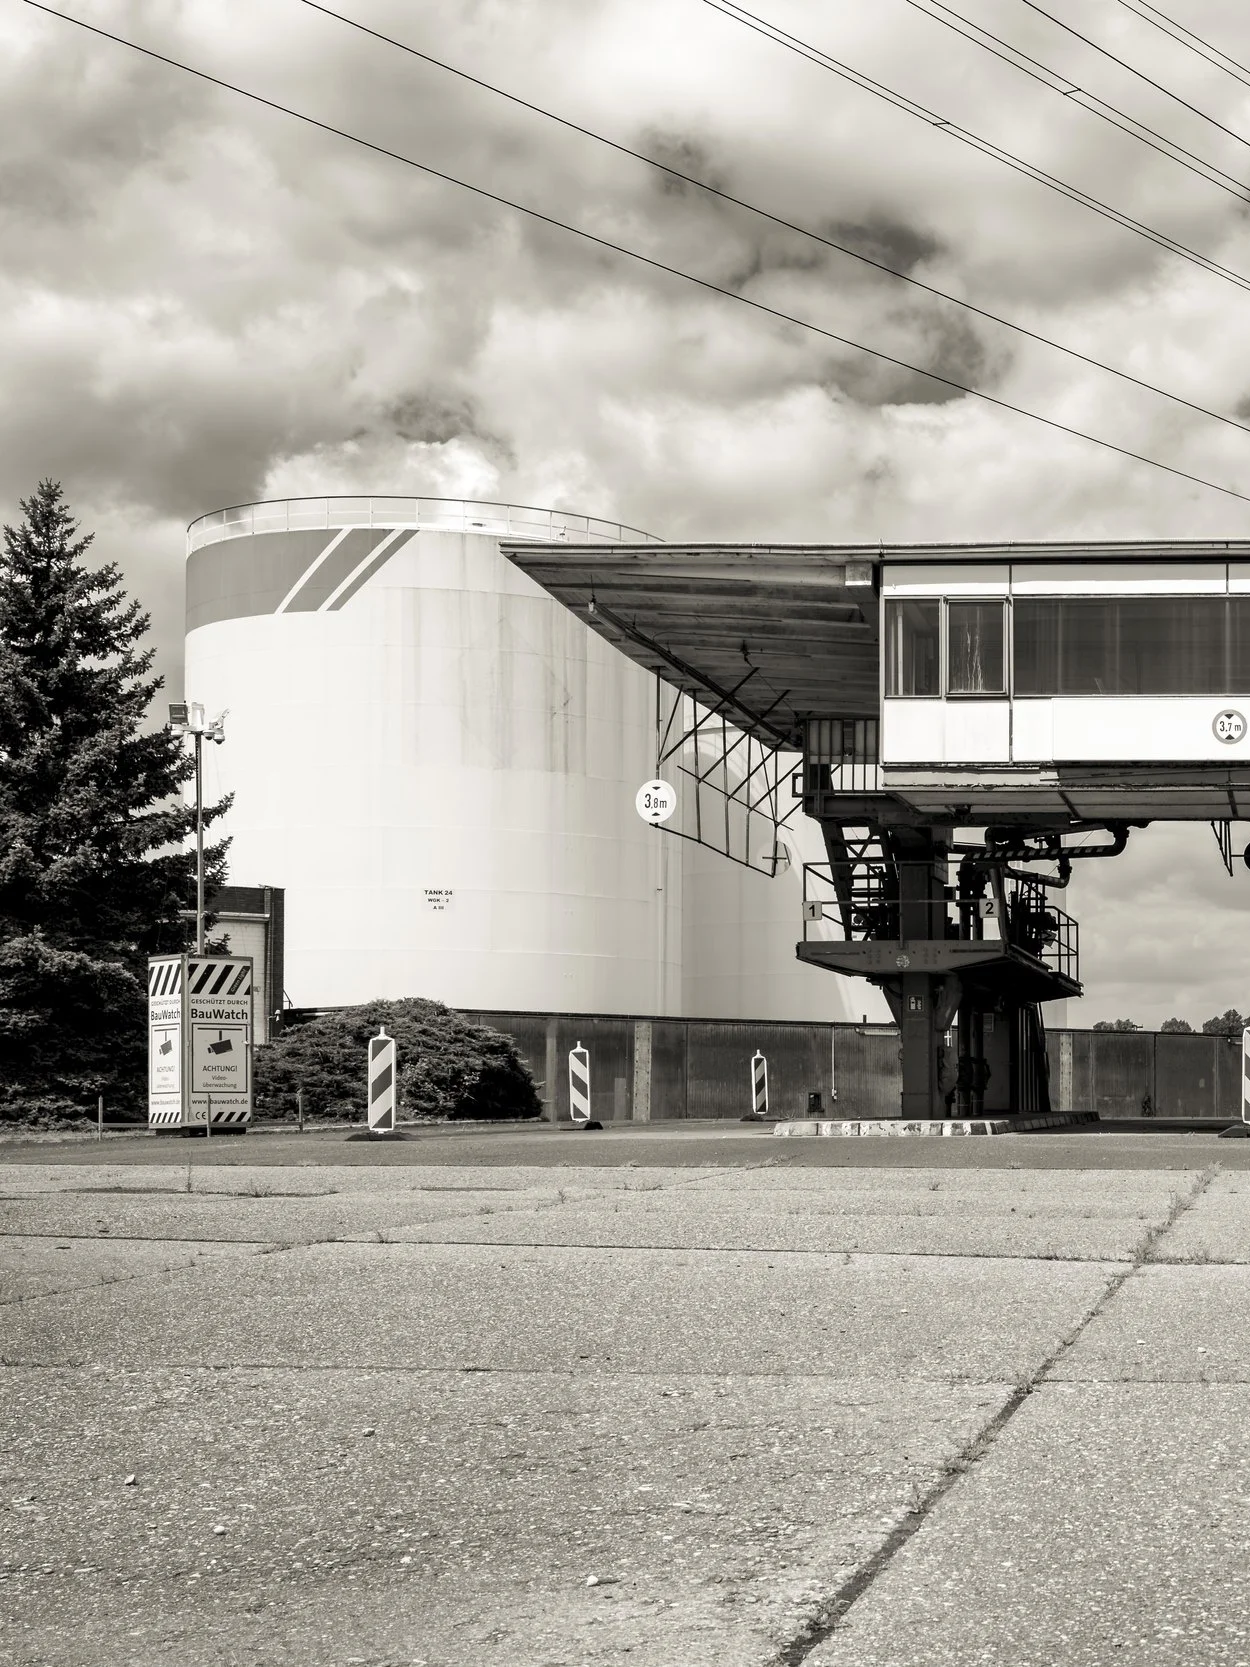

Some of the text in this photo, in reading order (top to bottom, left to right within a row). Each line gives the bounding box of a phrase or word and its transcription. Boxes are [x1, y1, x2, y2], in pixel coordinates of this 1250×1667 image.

[808, 904, 816, 917] 1
[985, 901, 994, 914] 2
[150, 1008, 180, 1021] BauWatch
[190, 1008, 248, 1020] BauWatch
